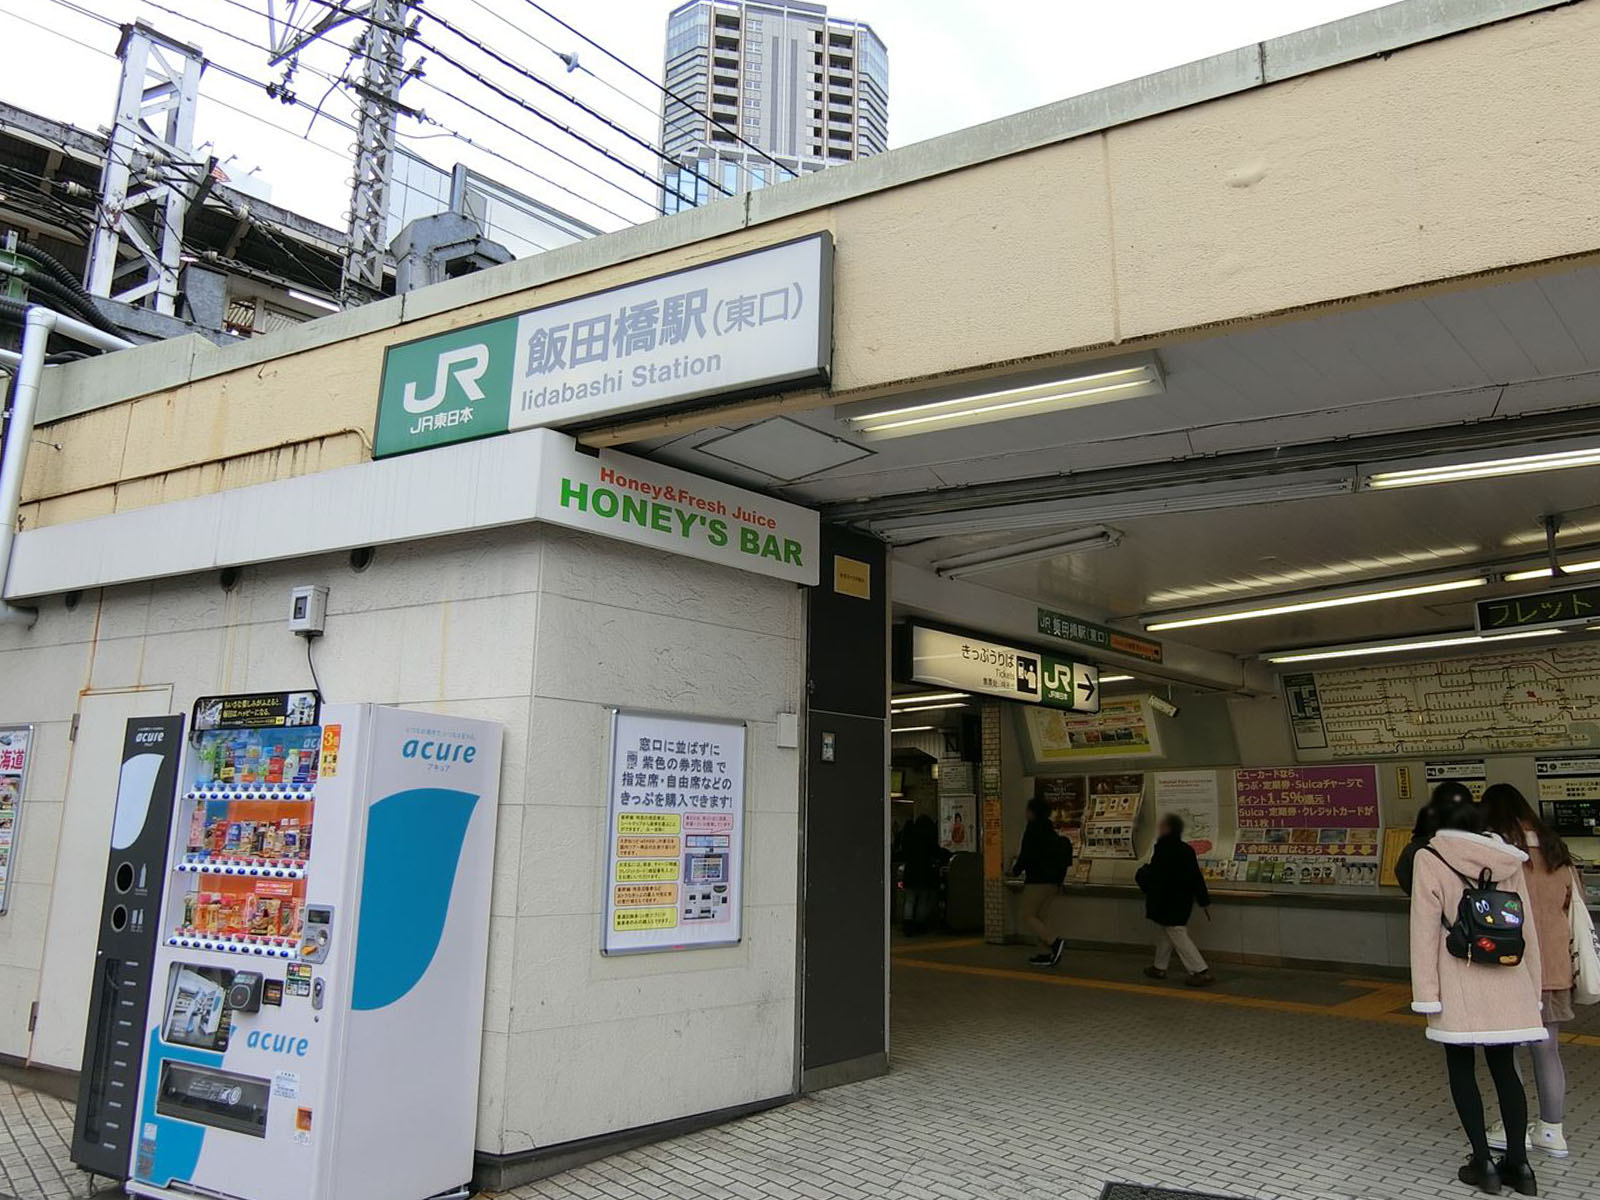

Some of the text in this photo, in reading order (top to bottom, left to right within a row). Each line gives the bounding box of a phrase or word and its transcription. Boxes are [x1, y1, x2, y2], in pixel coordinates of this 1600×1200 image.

[524, 282, 803, 378] 飯田橋駅(東口)
[403, 343, 490, 414] JR
[521, 353, 721, 411] Iidabashi Station
[409, 406, 474, 434] JR東日本
[599, 467, 777, 530] Honey&Fresh Juice
[559, 478, 804, 567] HONEY'S BAR
[961, 644, 1015, 668] きっぷうりば
[1044, 664, 1072, 692] JR
[135, 732, 165, 743] acure
[402, 740, 477, 763] acure
[639, 738, 721, 756] 窓口に並ばずに
[622, 771, 732, 791] 指定席・自由席などの
[247, 1030, 309, 1057] acure
